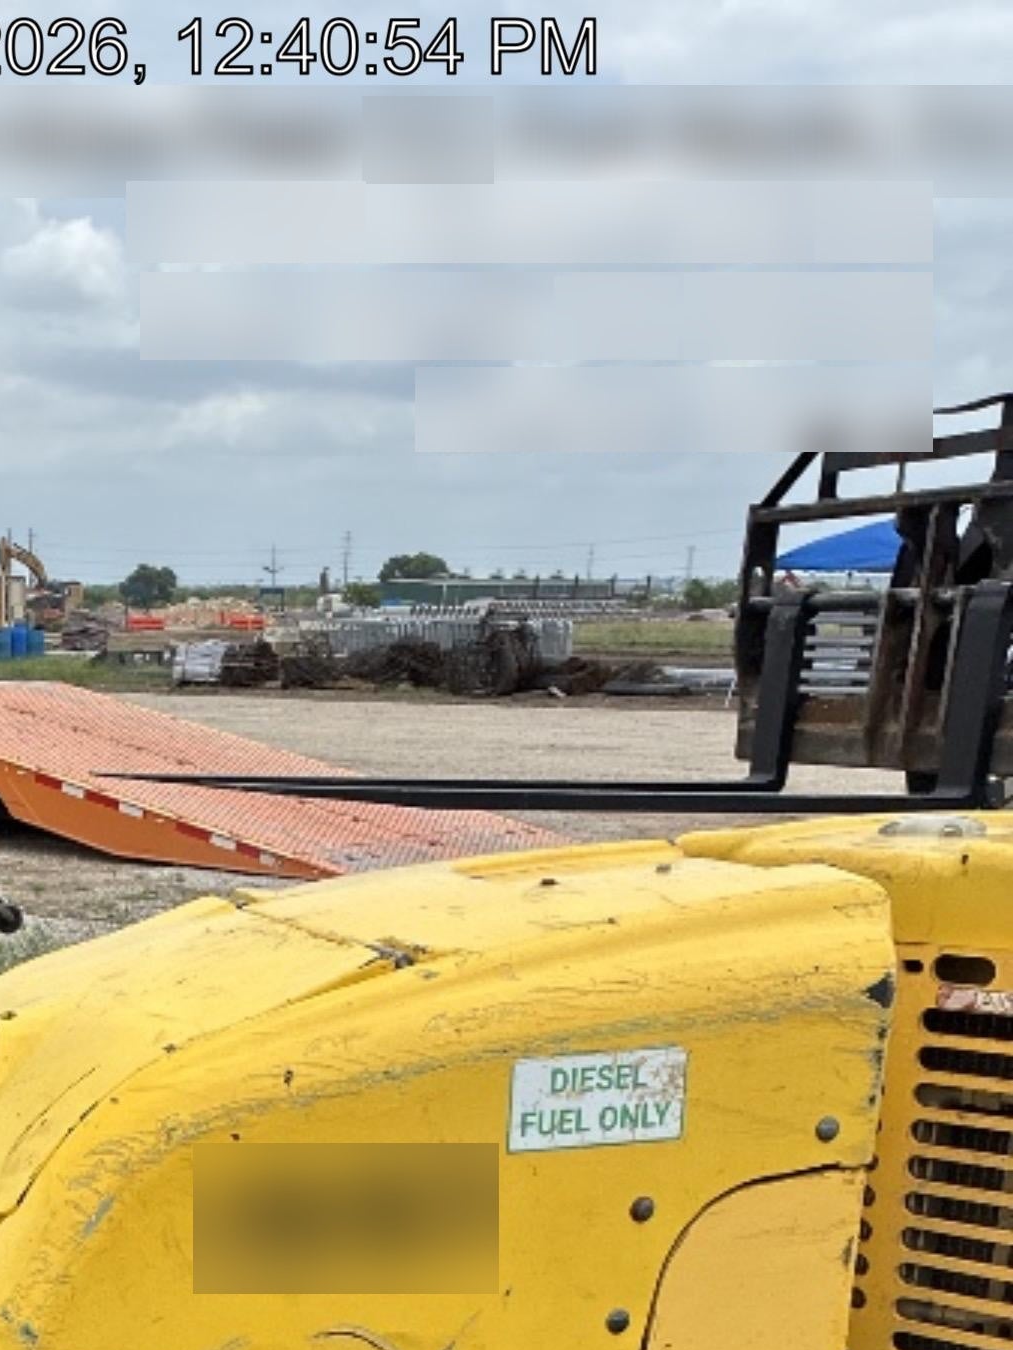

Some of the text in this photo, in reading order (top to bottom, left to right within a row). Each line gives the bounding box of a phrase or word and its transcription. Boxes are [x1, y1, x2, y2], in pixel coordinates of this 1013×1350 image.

[550, 1064, 648, 1094] DIESEL
[520, 1101, 672, 1138] FUEL ONLY
